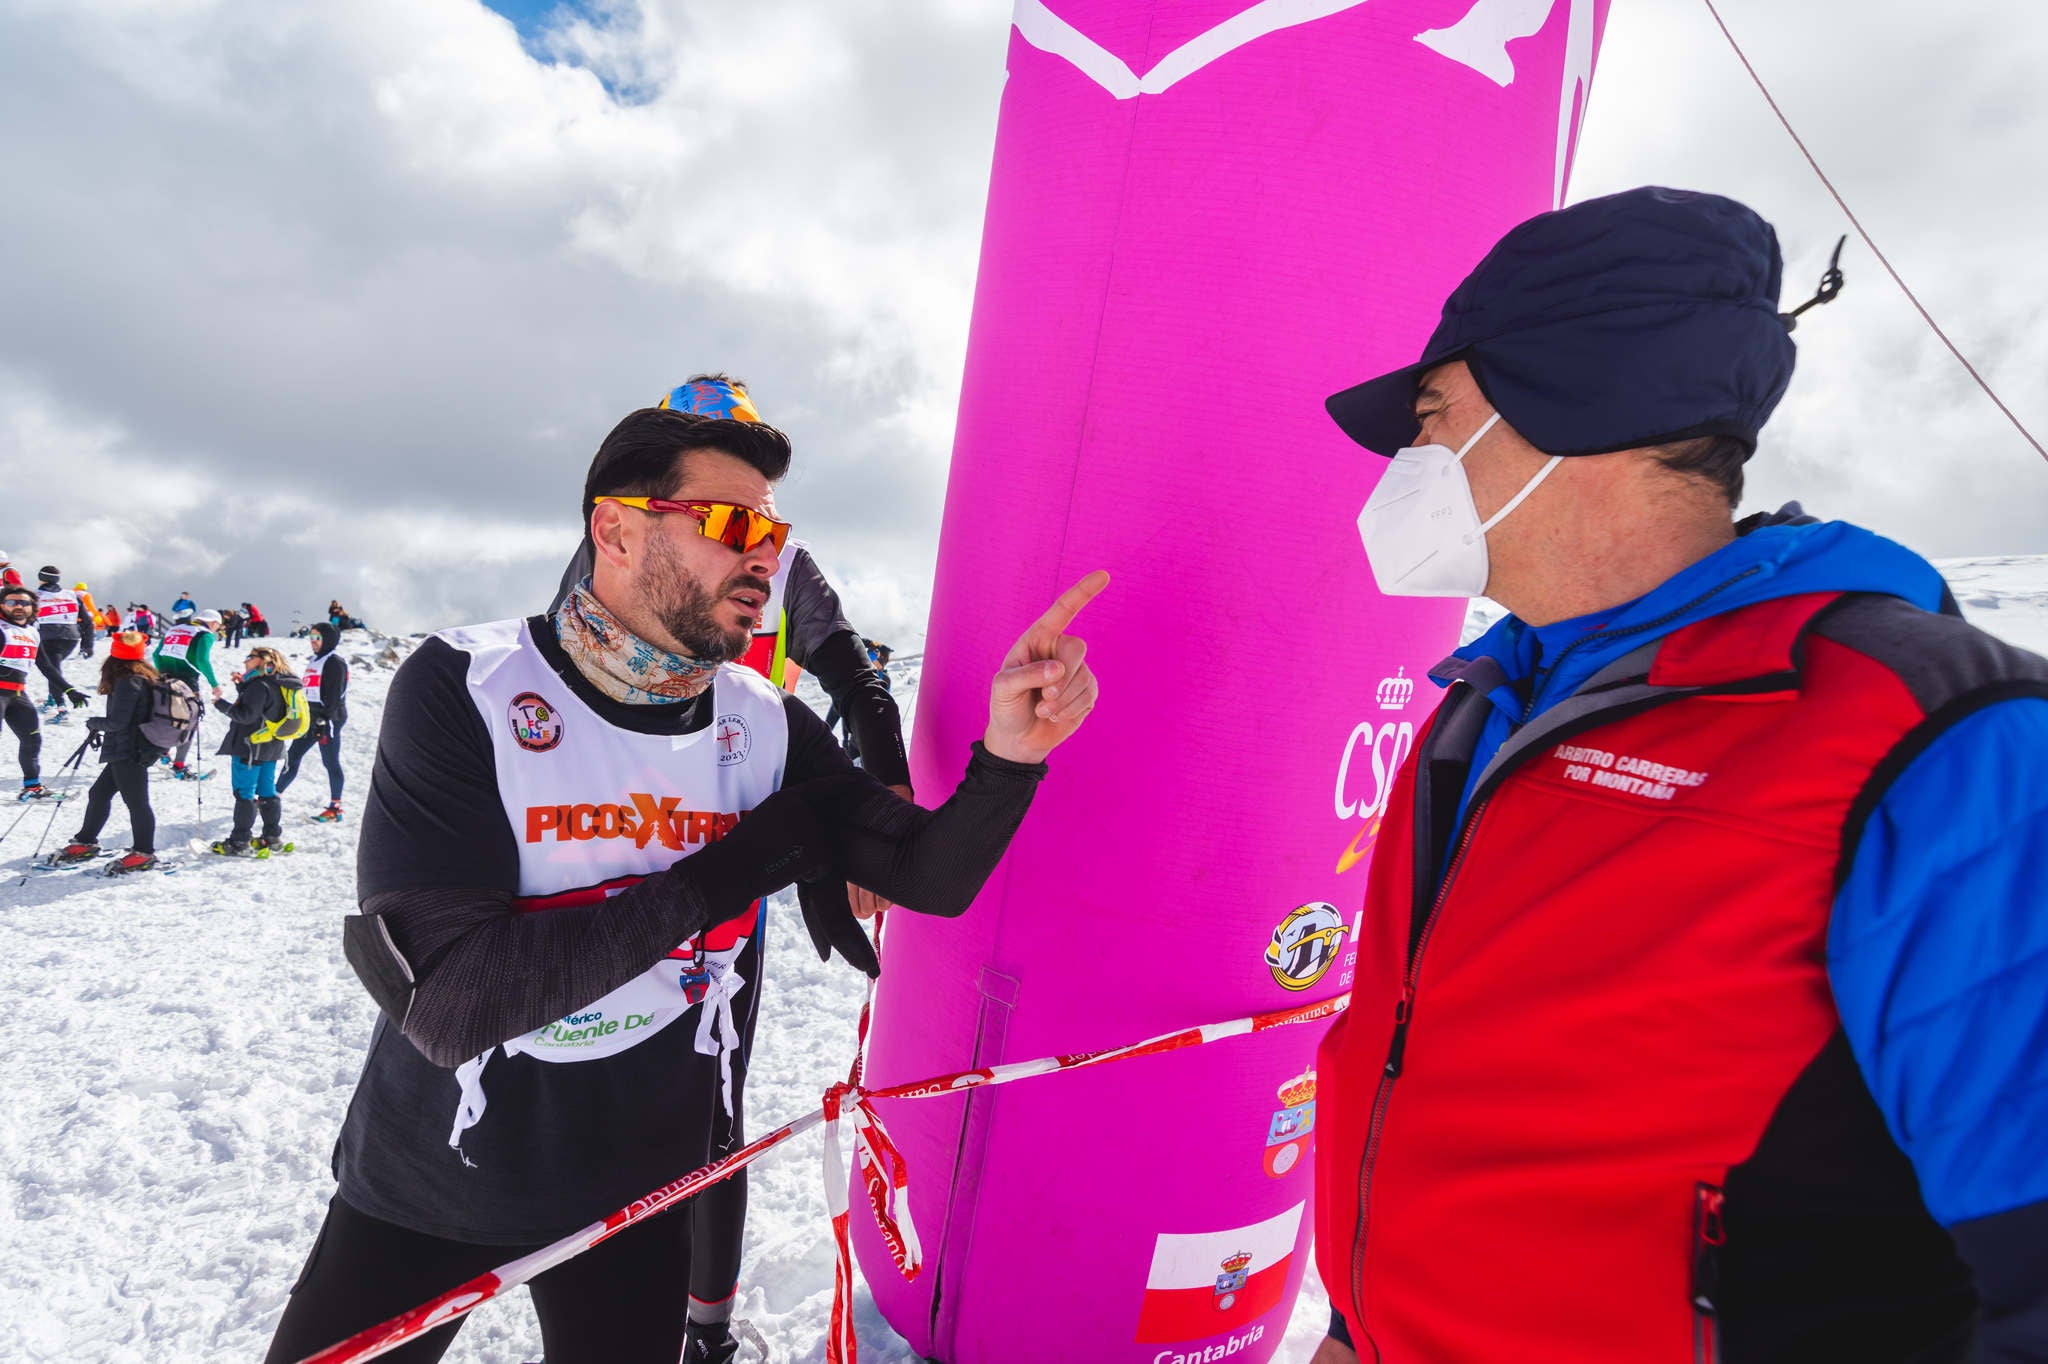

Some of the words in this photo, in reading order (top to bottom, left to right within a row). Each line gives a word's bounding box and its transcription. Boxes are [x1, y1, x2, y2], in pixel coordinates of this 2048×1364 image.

[50, 605, 69, 613] 38
[720, 750, 744, 762] 2023
[1554, 744, 1615, 768] ARBITRO
[1615, 756, 1708, 787] CARRERAS
[1563, 764, 1591, 782] POR
[1592, 770, 1676, 800] MONTAÑA
